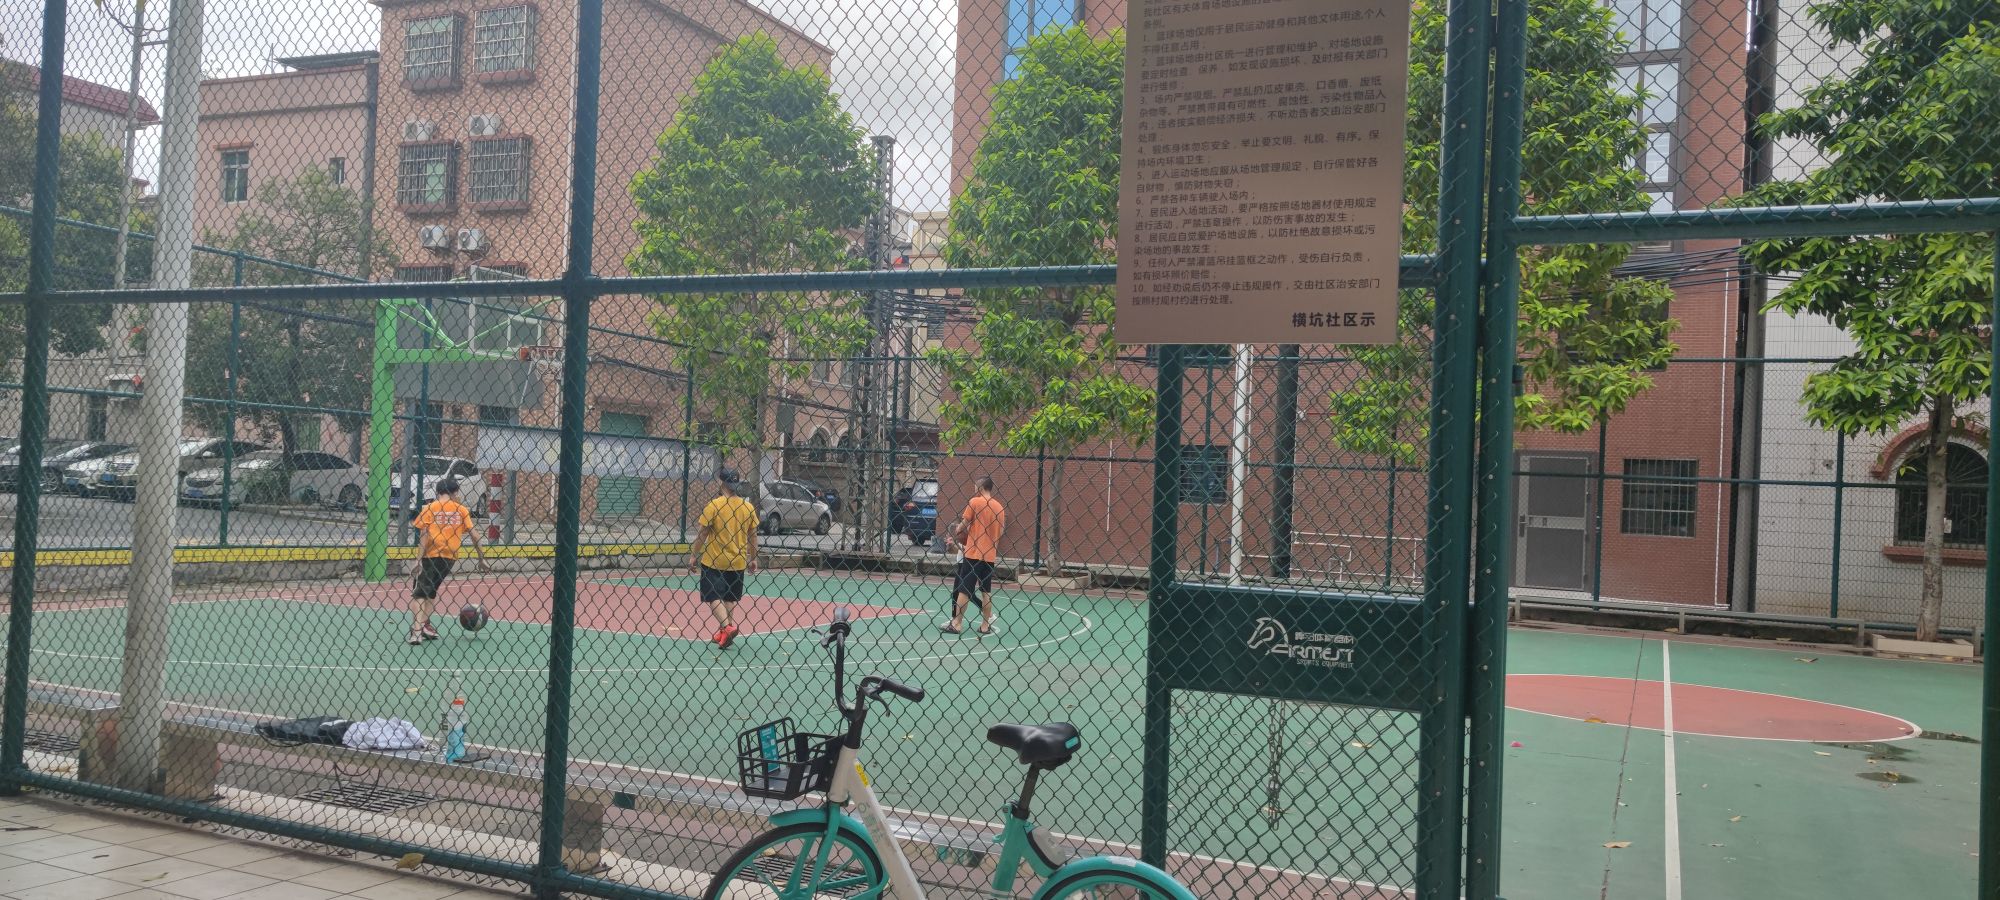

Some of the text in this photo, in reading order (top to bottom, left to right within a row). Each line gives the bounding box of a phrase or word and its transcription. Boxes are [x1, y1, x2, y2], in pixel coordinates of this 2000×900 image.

[1292, 312, 1376, 328] 横坑社区示
